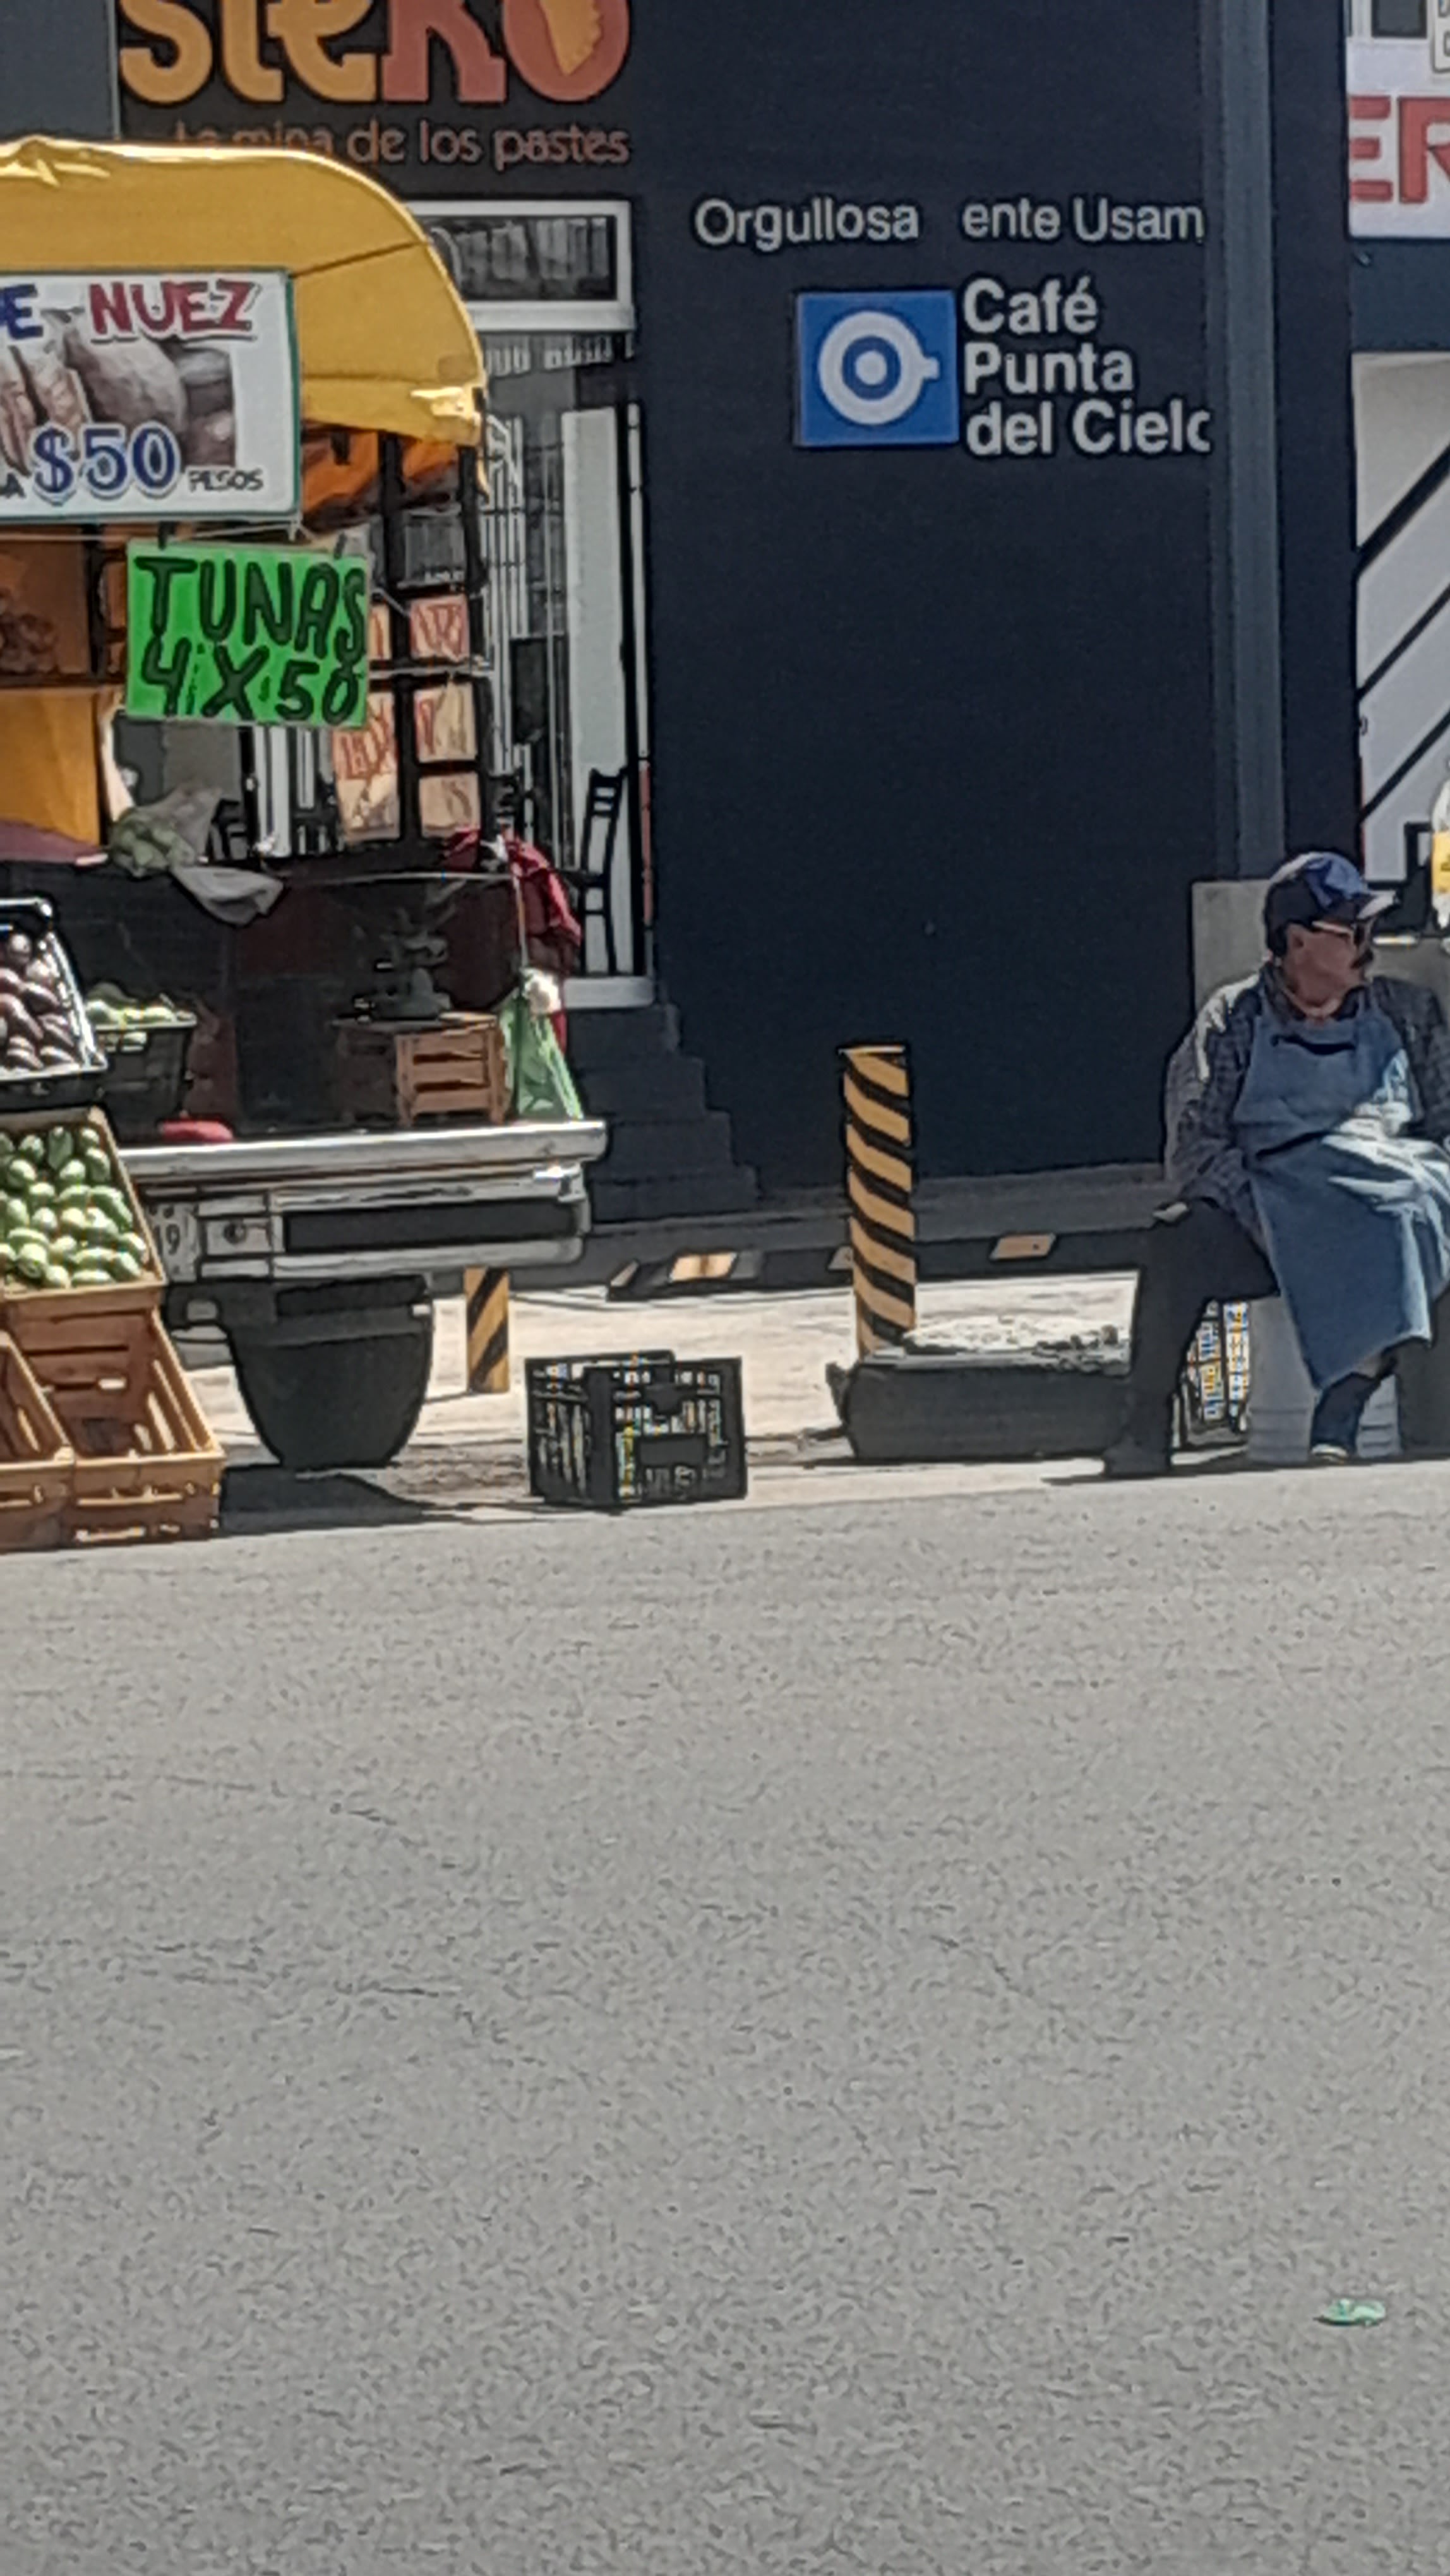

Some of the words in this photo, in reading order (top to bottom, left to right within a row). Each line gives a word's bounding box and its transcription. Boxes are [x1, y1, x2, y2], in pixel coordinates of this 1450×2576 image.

[347, 119, 404, 162] de
[420, 120, 481, 163] los
[493, 125, 630, 172] pastes
[693, 197, 920, 251] Orgullosa
[963, 198, 1060, 239] ente
[0, 283, 44, 340] E
[88, 280, 253, 335] NUEZ
[963, 275, 1099, 335] Café
[964, 342, 1134, 393] Punta
[966, 401, 1053, 455] del
[33, 427, 177, 493] $50
[134, 556, 366, 664] TUNAS
